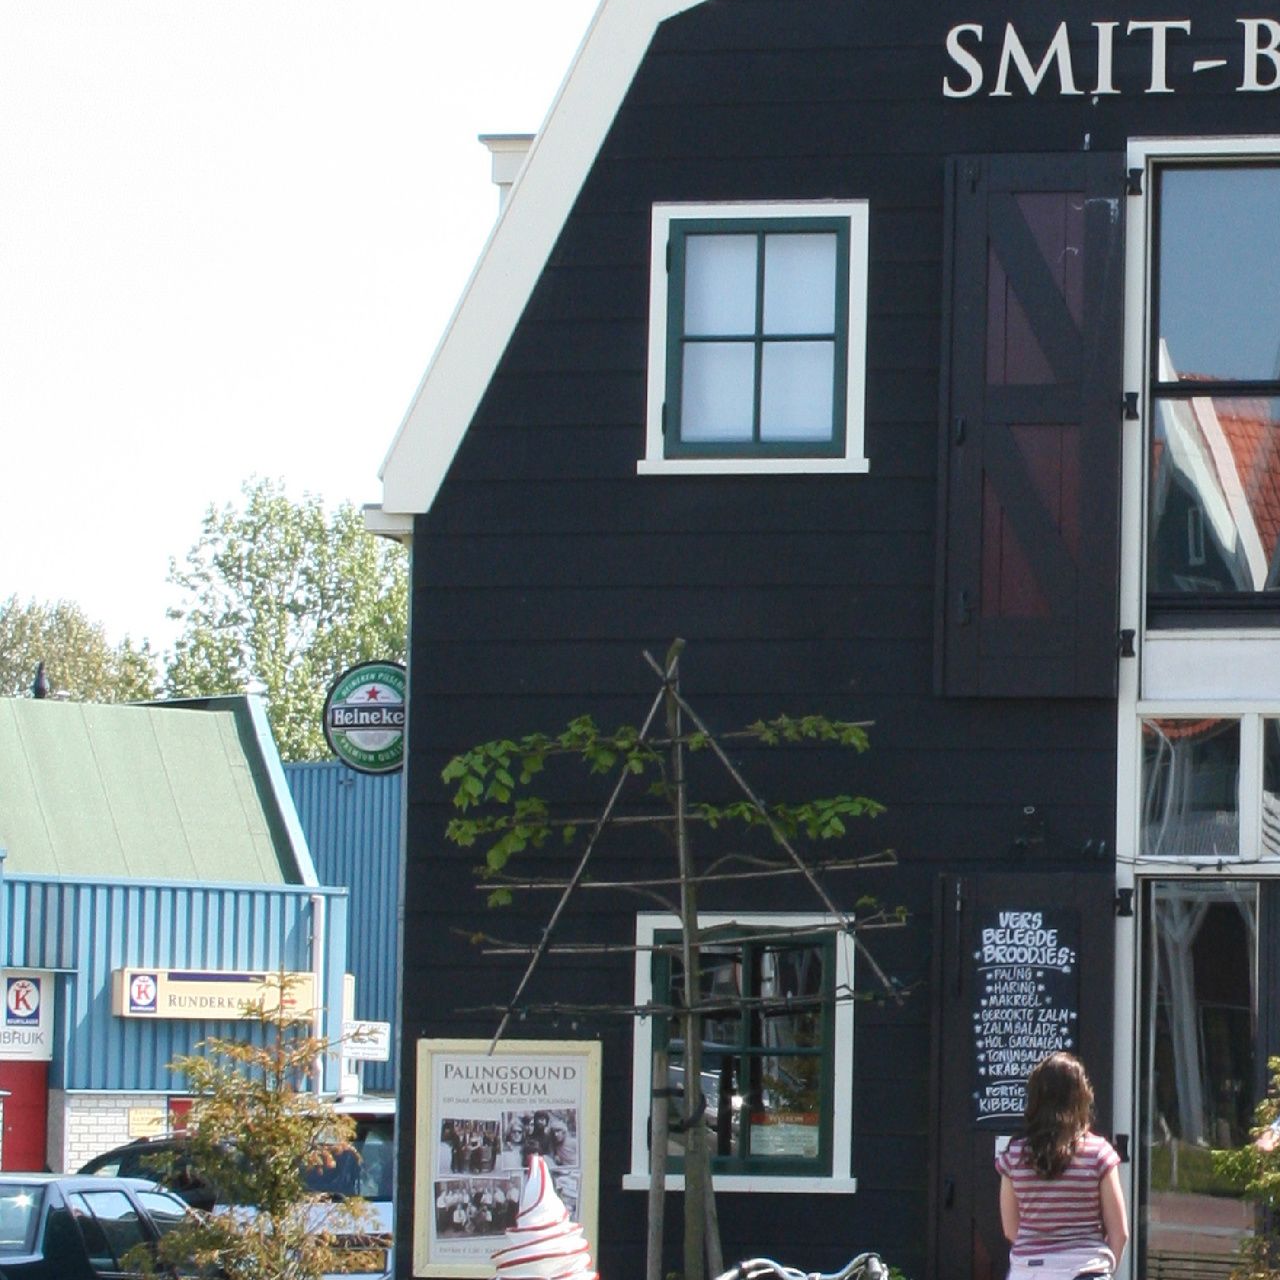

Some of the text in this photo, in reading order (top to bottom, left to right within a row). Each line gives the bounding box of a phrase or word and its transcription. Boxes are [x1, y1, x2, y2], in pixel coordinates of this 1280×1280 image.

[334, 708, 405, 725] Heineke
[999, 911, 1042, 930] VERS
[982, 928, 1058, 948] BELEGDE
[982, 945, 1075, 966] BROODJES:
[994, 981, 1036, 994] HARING
[1037, 1008, 1068, 1024] ZALM
[0, 1031, 44, 1045] BRUIK
[443, 1063, 577, 1080] PALINGSOUND
[470, 1081, 548, 1096] MUSEUM
